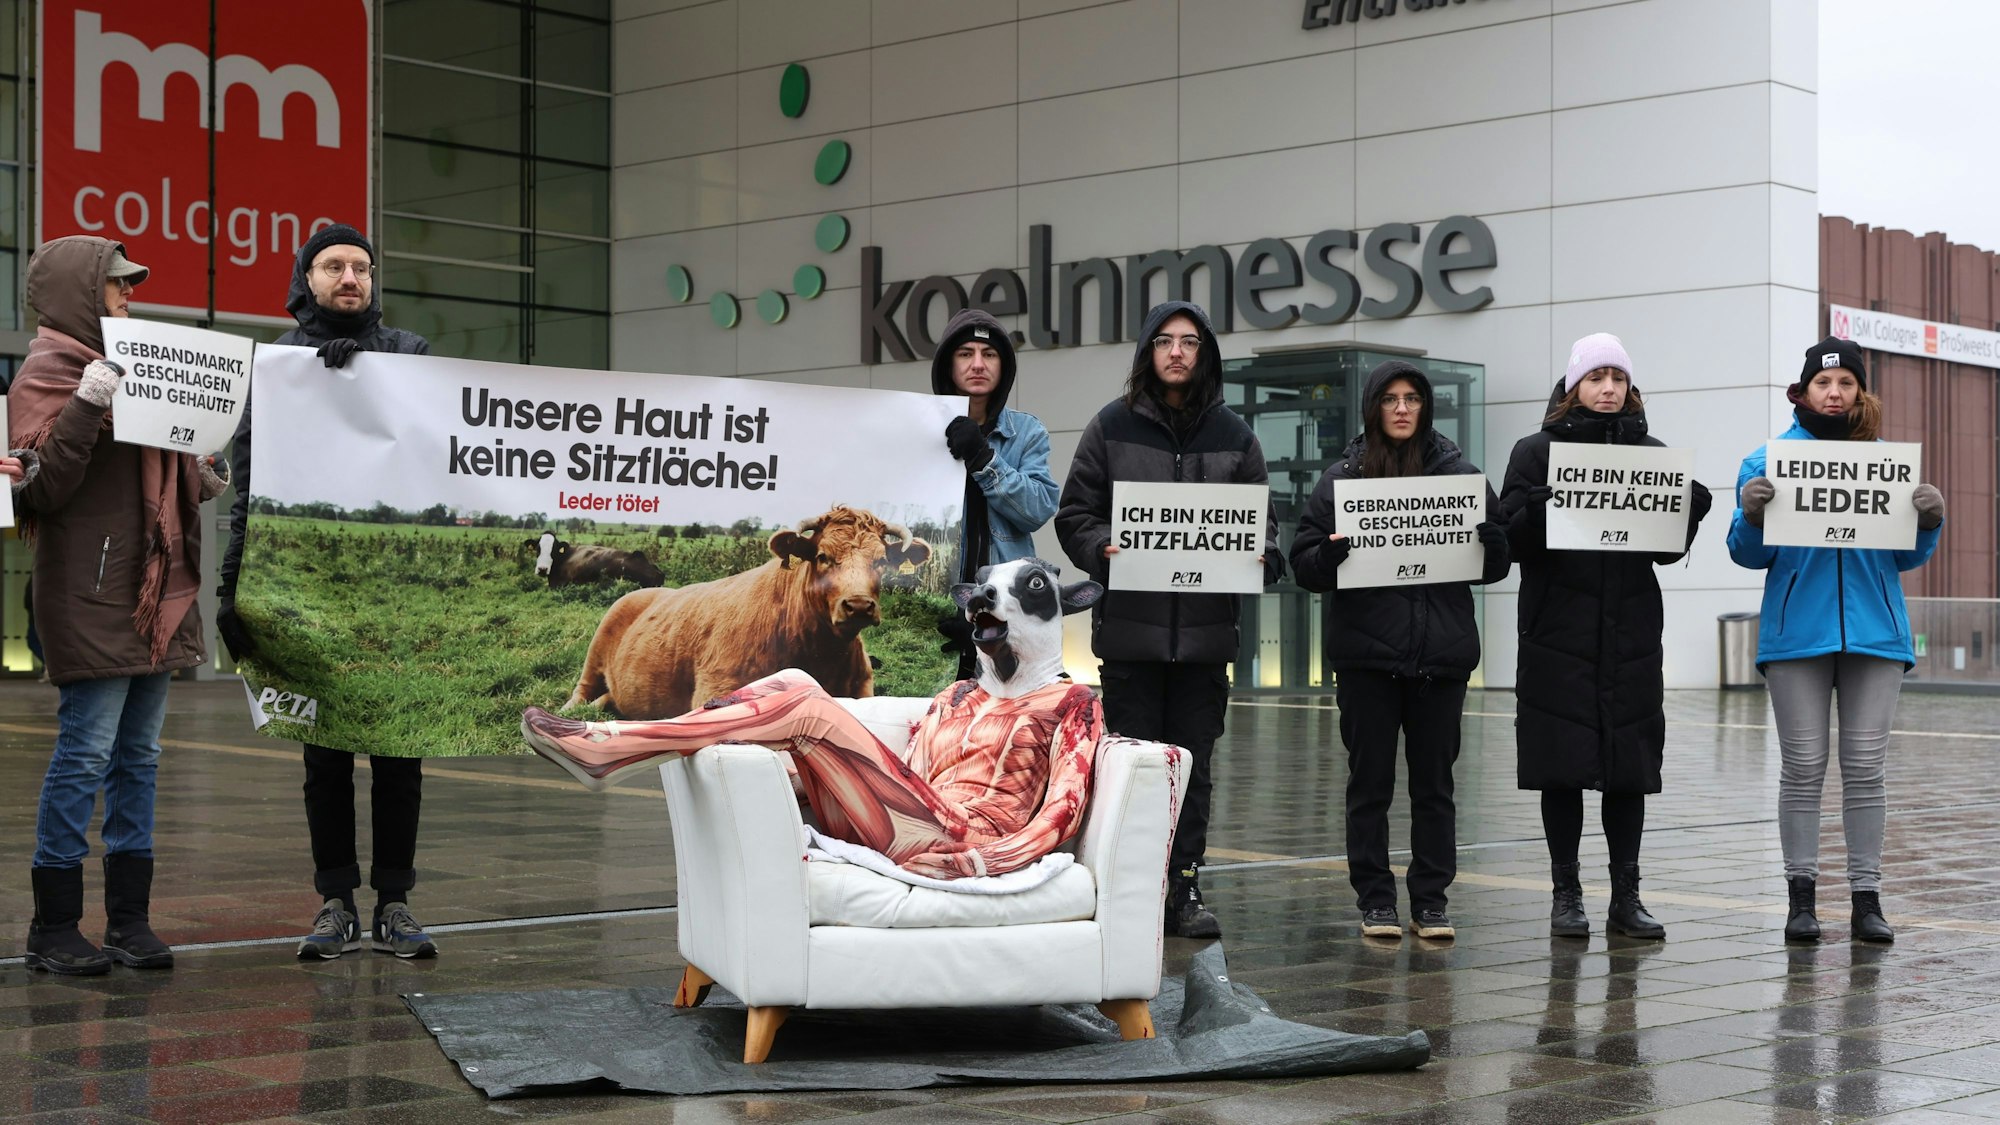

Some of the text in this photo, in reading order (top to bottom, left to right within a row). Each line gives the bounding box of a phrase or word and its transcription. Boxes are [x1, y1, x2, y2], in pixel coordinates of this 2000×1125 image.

[861, 215, 1497, 364] koelnmesse
[1853, 315, 1870, 337] ISM
[1874, 320, 1918, 348] Cologne
[1941, 330, 1991, 358] ProSweets
[115, 340, 244, 378] GEBRANDMARKT,
[133, 362, 231, 393] GESCHLAGEN
[125, 381, 236, 415] UND GEHÄUTET
[461, 386, 770, 444] Unsere Haut ist
[449, 435, 778, 491] keine Sitzfläche!
[1776, 458, 1911, 483] LEIDEN FÜR
[1556, 467, 1684, 487] ICH BIN KEINE
[558, 491, 660, 513] Leder tötet
[1343, 495, 1478, 513] GEBRANDMARKT,
[1553, 487, 1682, 513] SITZFLÄCHE
[1795, 487, 1890, 515] LEDER
[1122, 507, 1257, 525] ICH BIN KEINE
[1359, 513, 1464, 530] GESCHLAGEN
[1119, 526, 1256, 551] SITZFLÄCHE
[1351, 529, 1473, 549] UND GEHÄUTET
